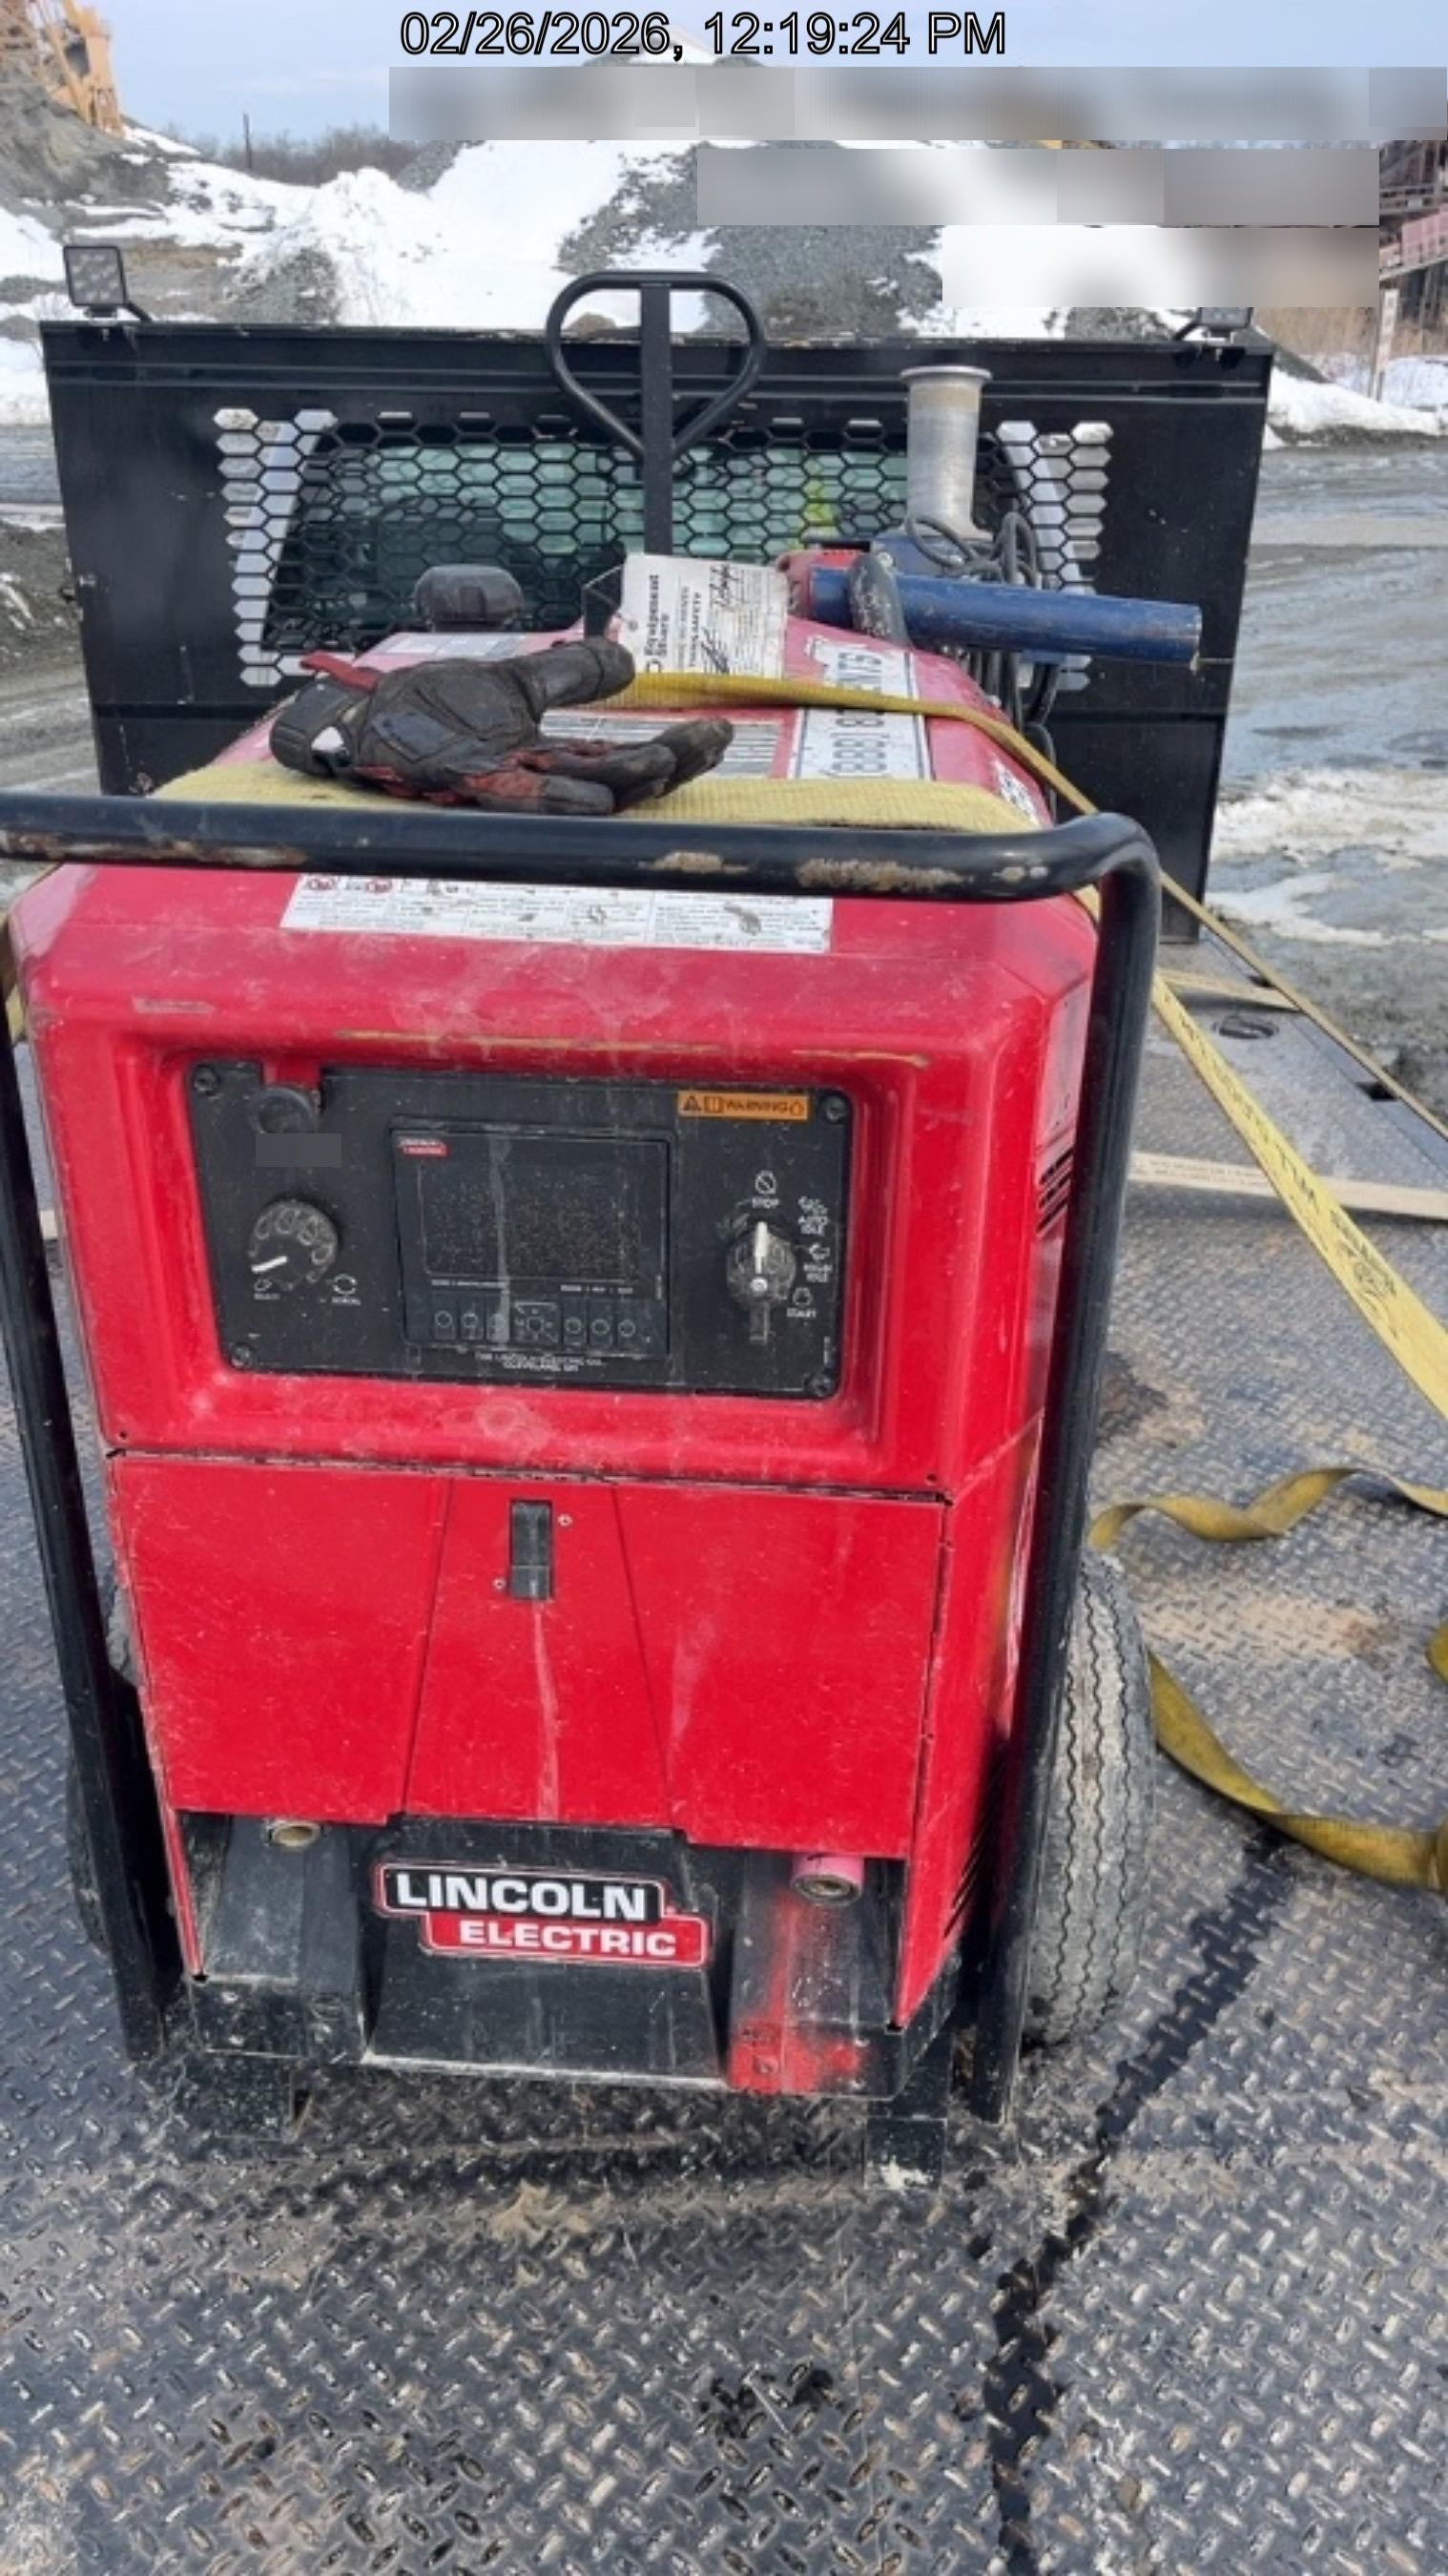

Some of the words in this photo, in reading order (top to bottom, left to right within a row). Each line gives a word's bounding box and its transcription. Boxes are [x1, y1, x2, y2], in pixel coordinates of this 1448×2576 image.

[726, 1100, 788, 1113] WARNING
[396, 1873, 646, 1922] LINCOLN
[459, 1920, 676, 1957] ELECTRIC
